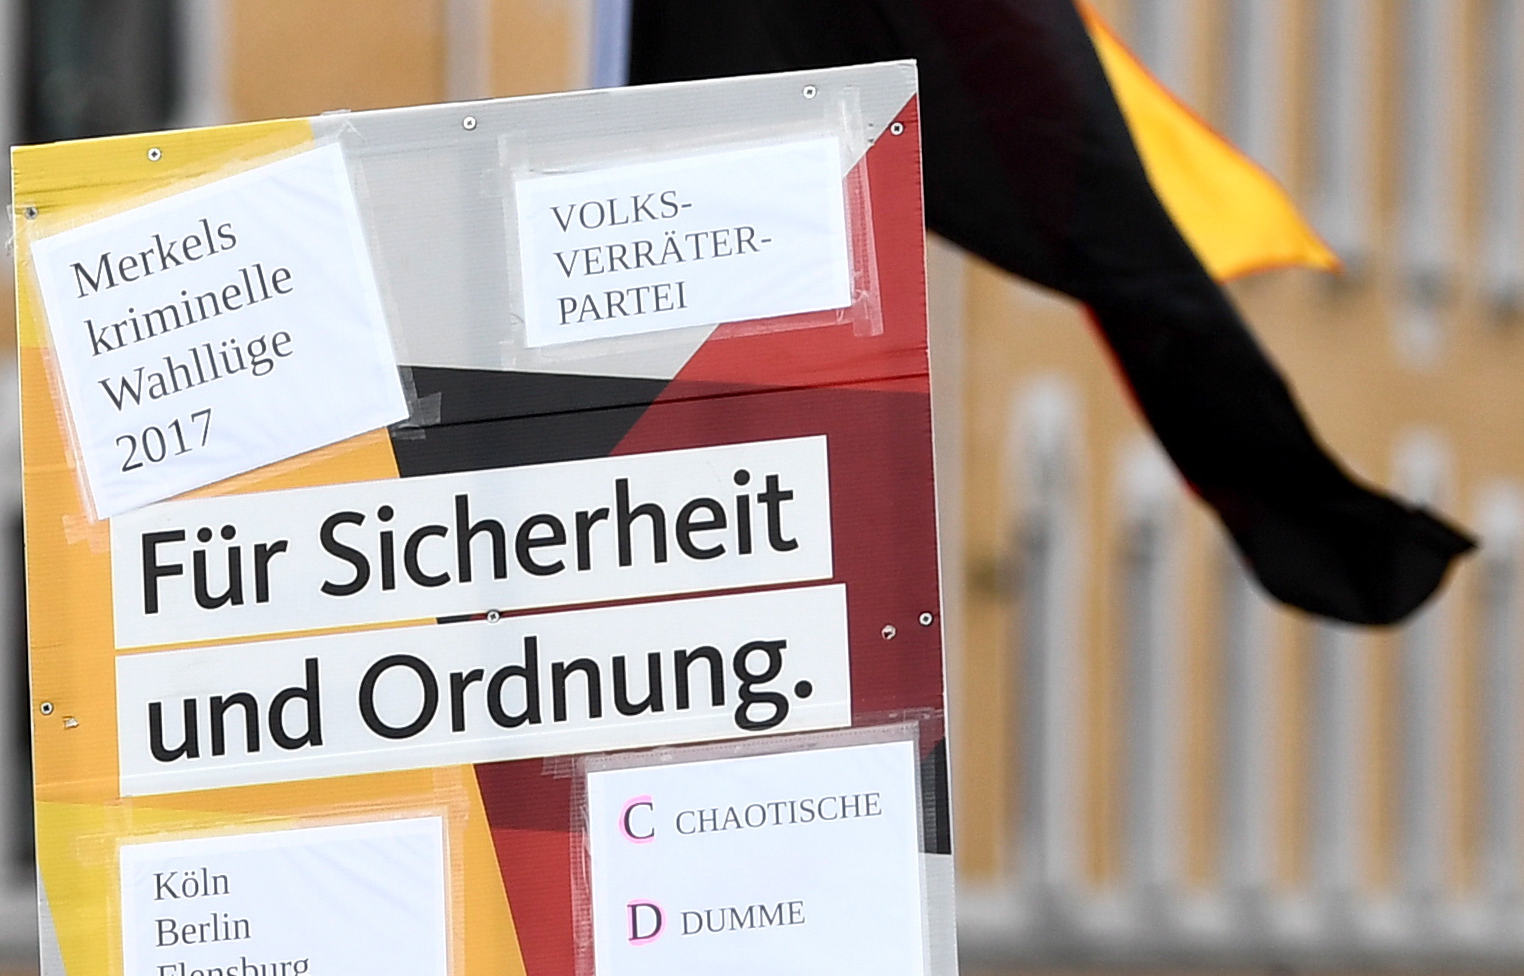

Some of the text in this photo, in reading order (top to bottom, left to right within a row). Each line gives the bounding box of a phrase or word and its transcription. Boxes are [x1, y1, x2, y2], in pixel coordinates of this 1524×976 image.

[550, 189, 693, 233] VOLKS-
[70, 218, 238, 299] Merkels
[553, 224, 773, 279] VERRÄTER-
[83, 263, 295, 357] kriminelle
[557, 281, 688, 325] PARTEI
[97, 328, 295, 412] Wahllüge
[115, 407, 214, 473] 2017
[142, 469, 799, 614] Für Sicherheit
[148, 636, 814, 762] und Ordnung.
[623, 792, 882, 840] C CHAOTISCHE
[153, 867, 230, 901] Köln
[154, 913, 251, 947] Berlin
[626, 901, 806, 941] D DUMME
